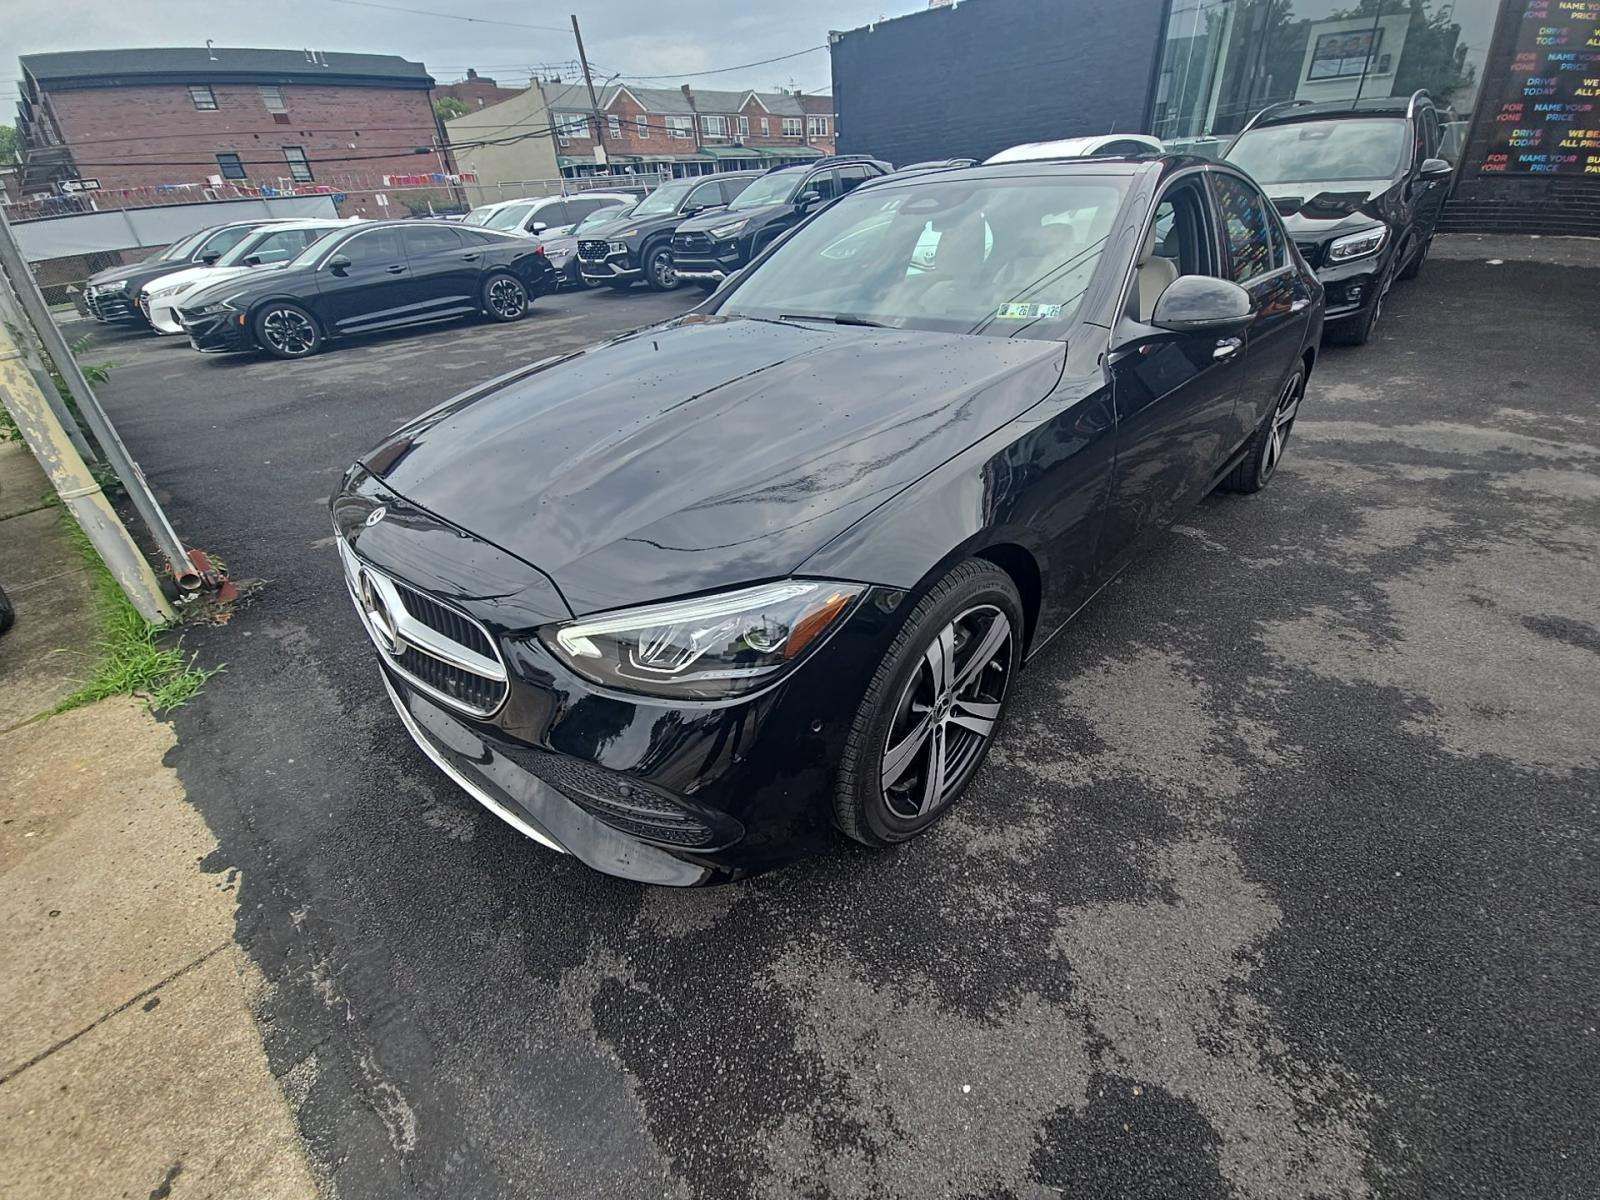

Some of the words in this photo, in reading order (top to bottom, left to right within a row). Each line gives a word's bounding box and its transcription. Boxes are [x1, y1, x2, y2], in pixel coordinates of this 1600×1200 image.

[1571, 12, 1597, 20] PRICE
[1548, 53, 1576, 61] NAME
[1526, 78, 1557, 86] DRIVE
[1584, 78, 1600, 86] WE
[1523, 88, 1556, 96] TODAY
[1575, 88, 1593, 96] ALL
[1502, 103, 1524, 111] FOR
[1546, 113, 1575, 121] PRICE
[1512, 129, 1543, 137] DRIVE
[1509, 139, 1541, 147] TODAY
[1488, 154, 1508, 162] FOR
[1530, 164, 1560, 172] PRICE
